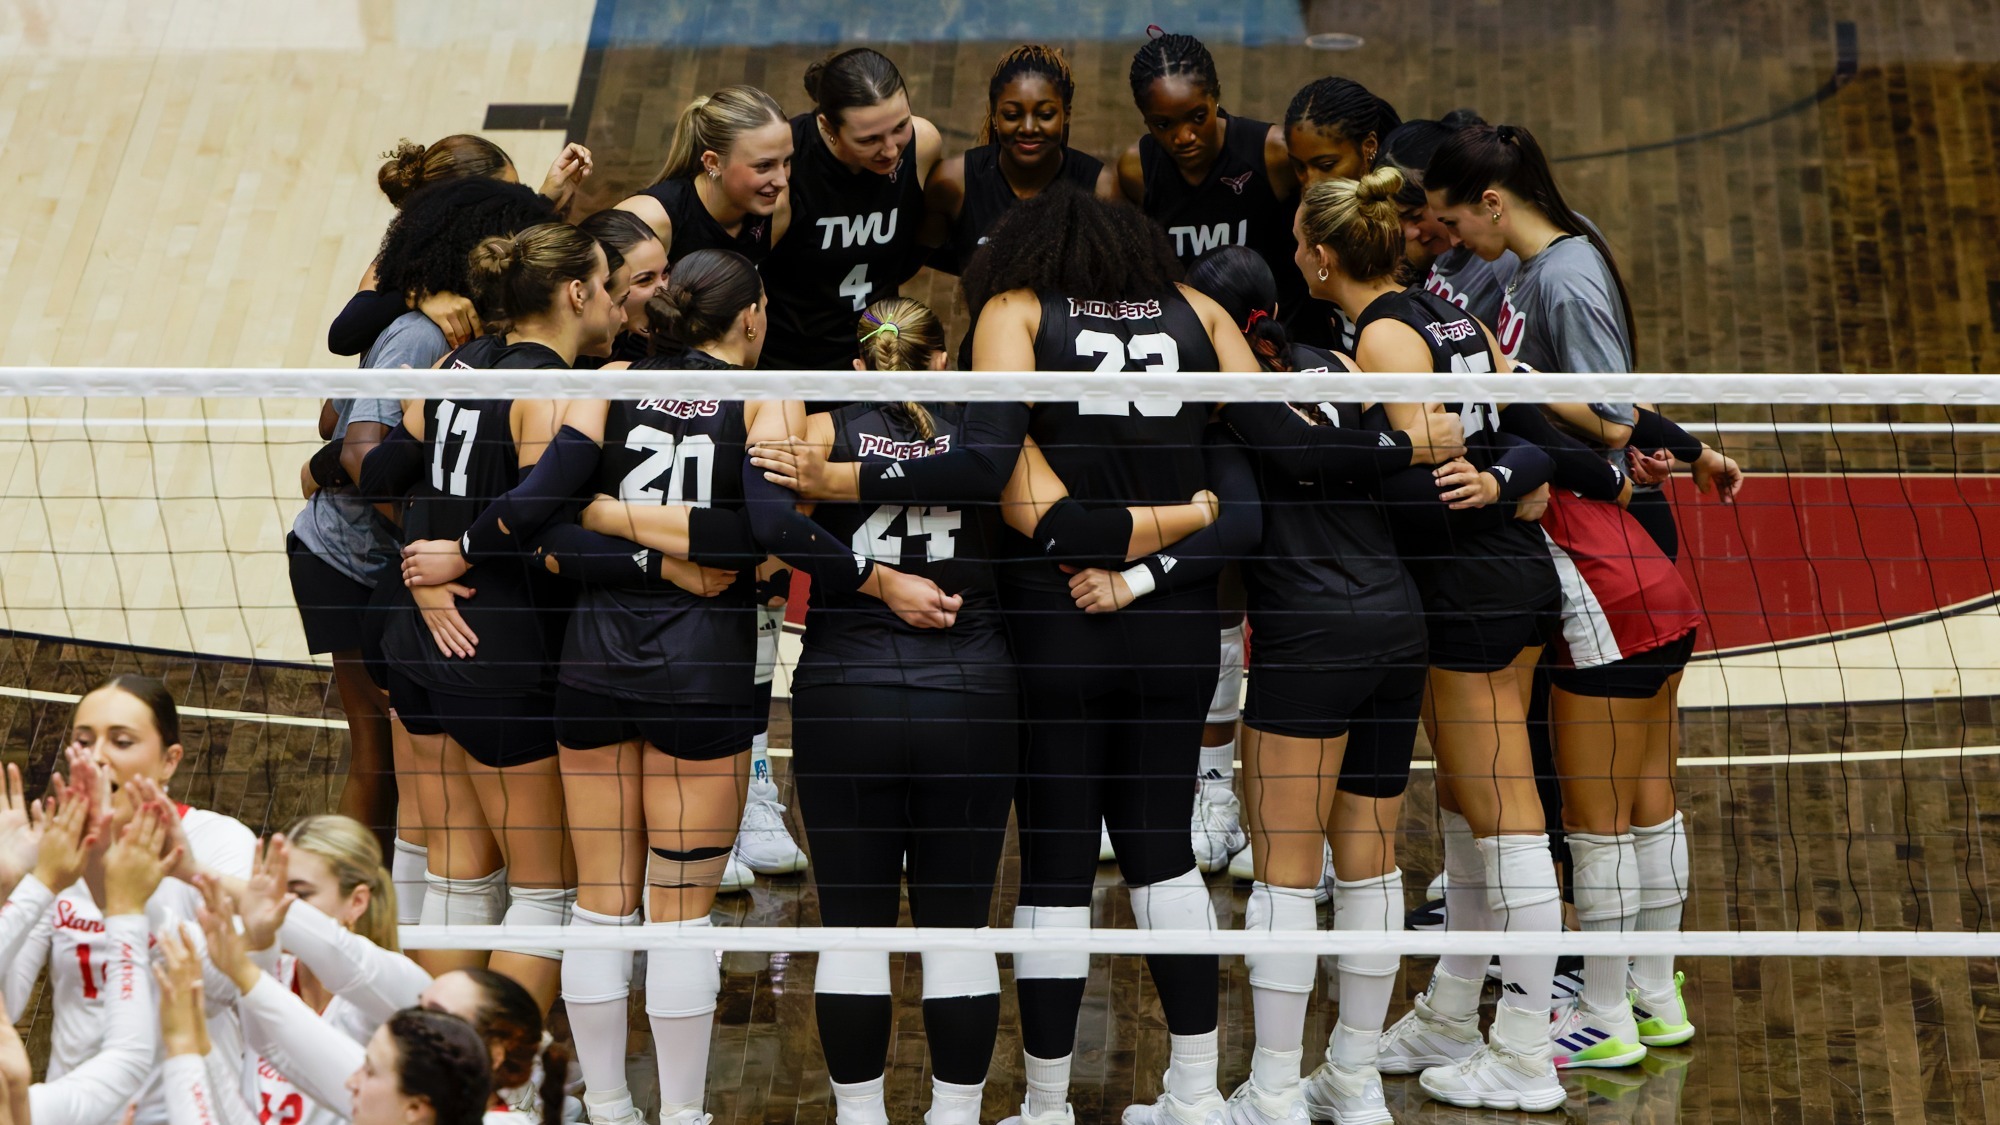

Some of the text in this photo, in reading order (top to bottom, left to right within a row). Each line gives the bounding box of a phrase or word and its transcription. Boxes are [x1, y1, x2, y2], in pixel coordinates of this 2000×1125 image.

[816, 208, 898, 250] TWU
[1168, 219, 1247, 257] TWU
[839, 263, 873, 312] 4
[1075, 329, 1183, 417] 23
[432, 399, 481, 497] 17
[619, 424, 715, 509] 20
